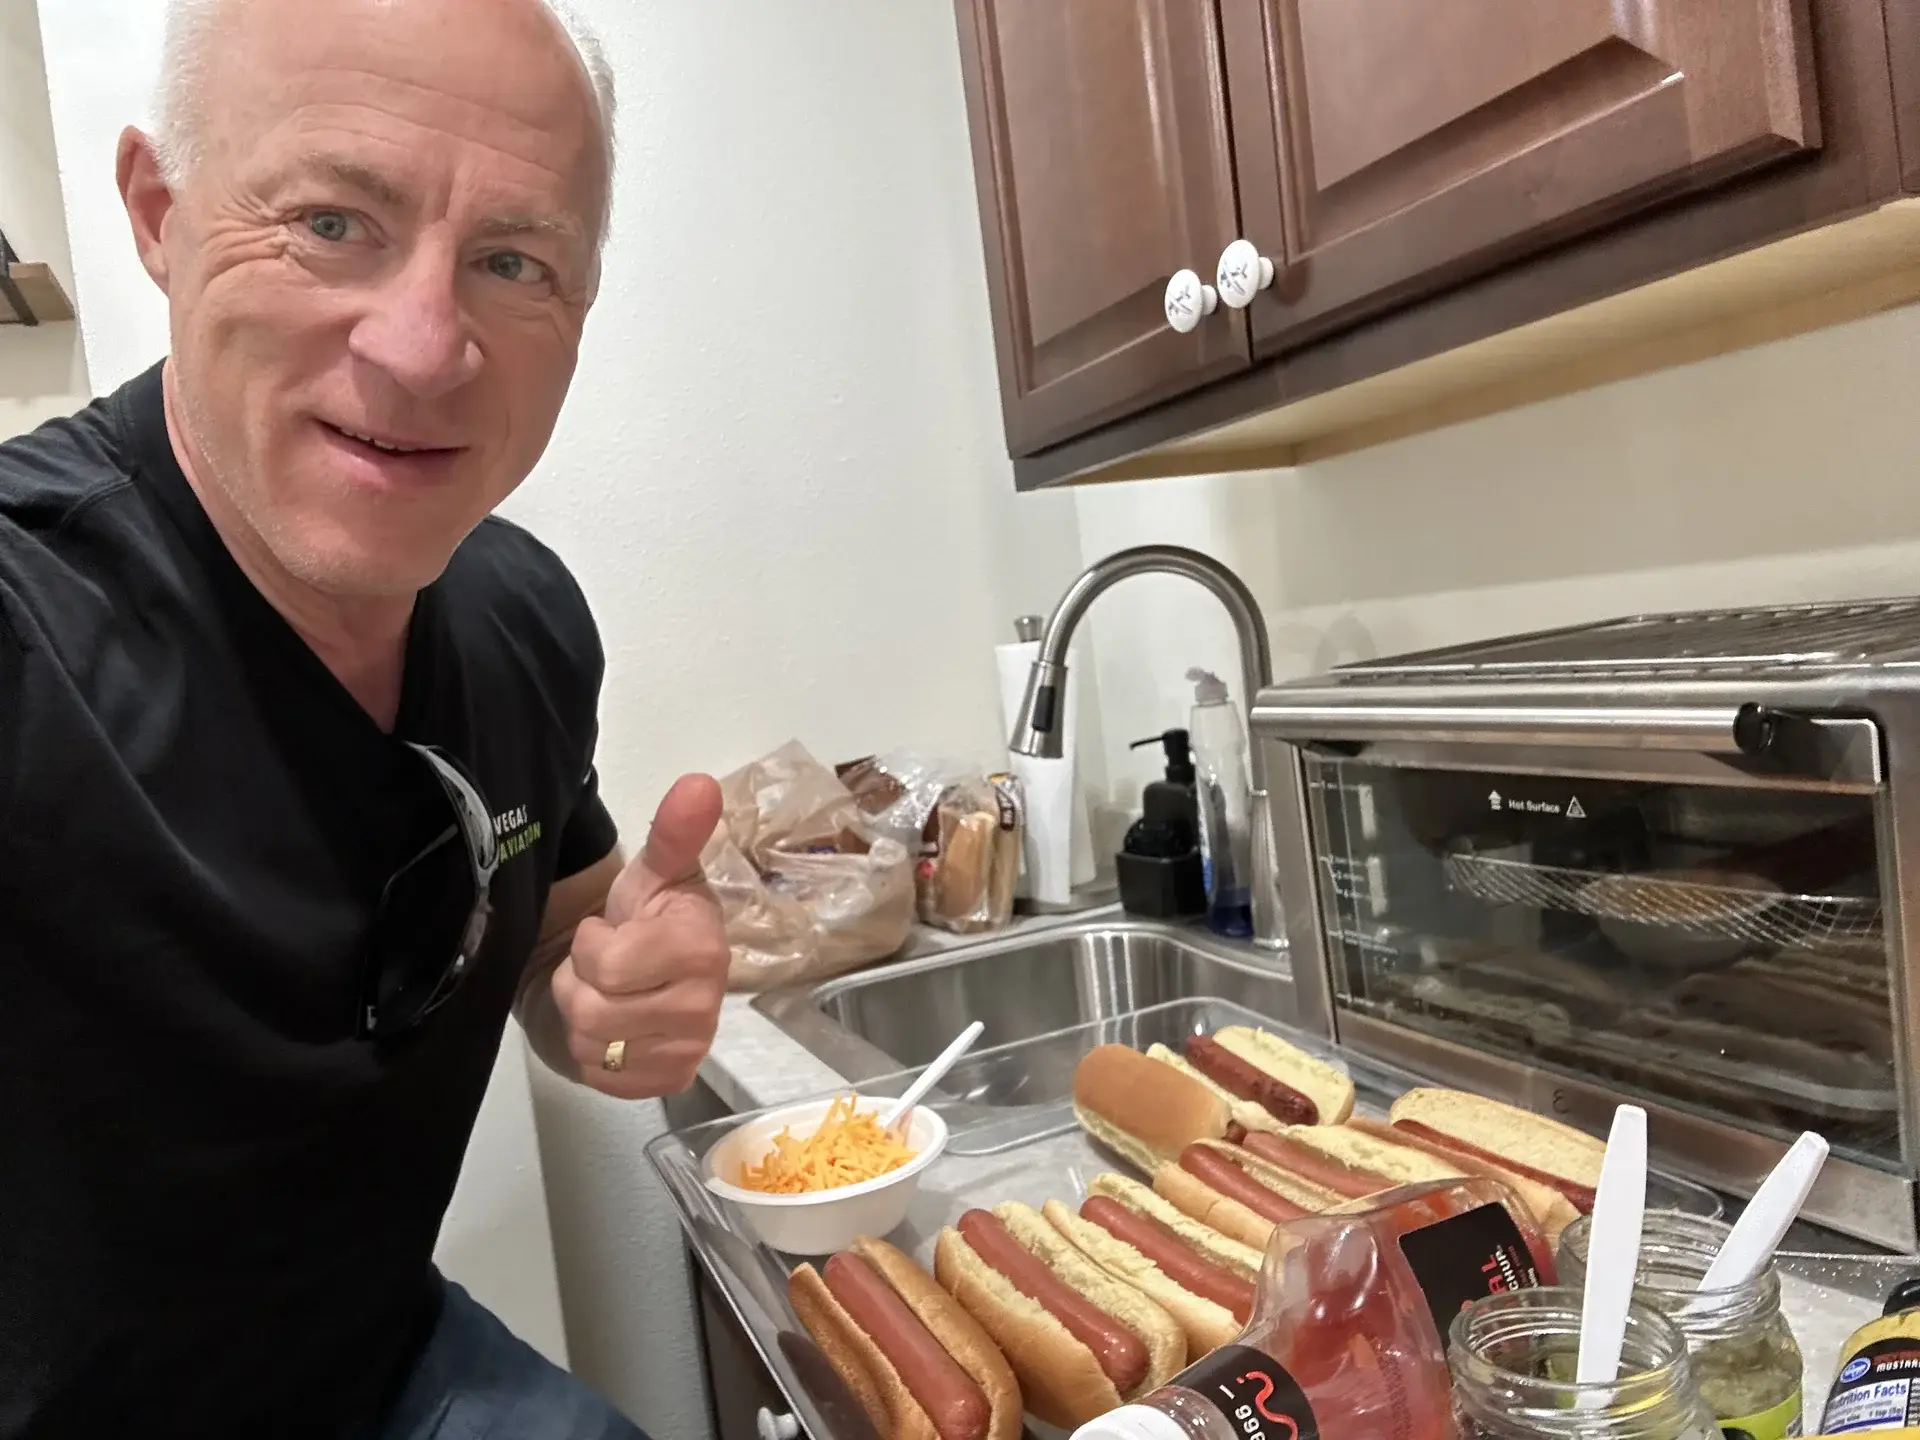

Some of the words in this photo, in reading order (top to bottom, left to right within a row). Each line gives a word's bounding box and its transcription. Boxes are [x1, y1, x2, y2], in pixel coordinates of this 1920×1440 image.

[492, 803, 528, 836] VEGAS
[1876, 1357, 1920, 1374] MUSTAR
[1873, 1382, 1907, 1399] Facts
